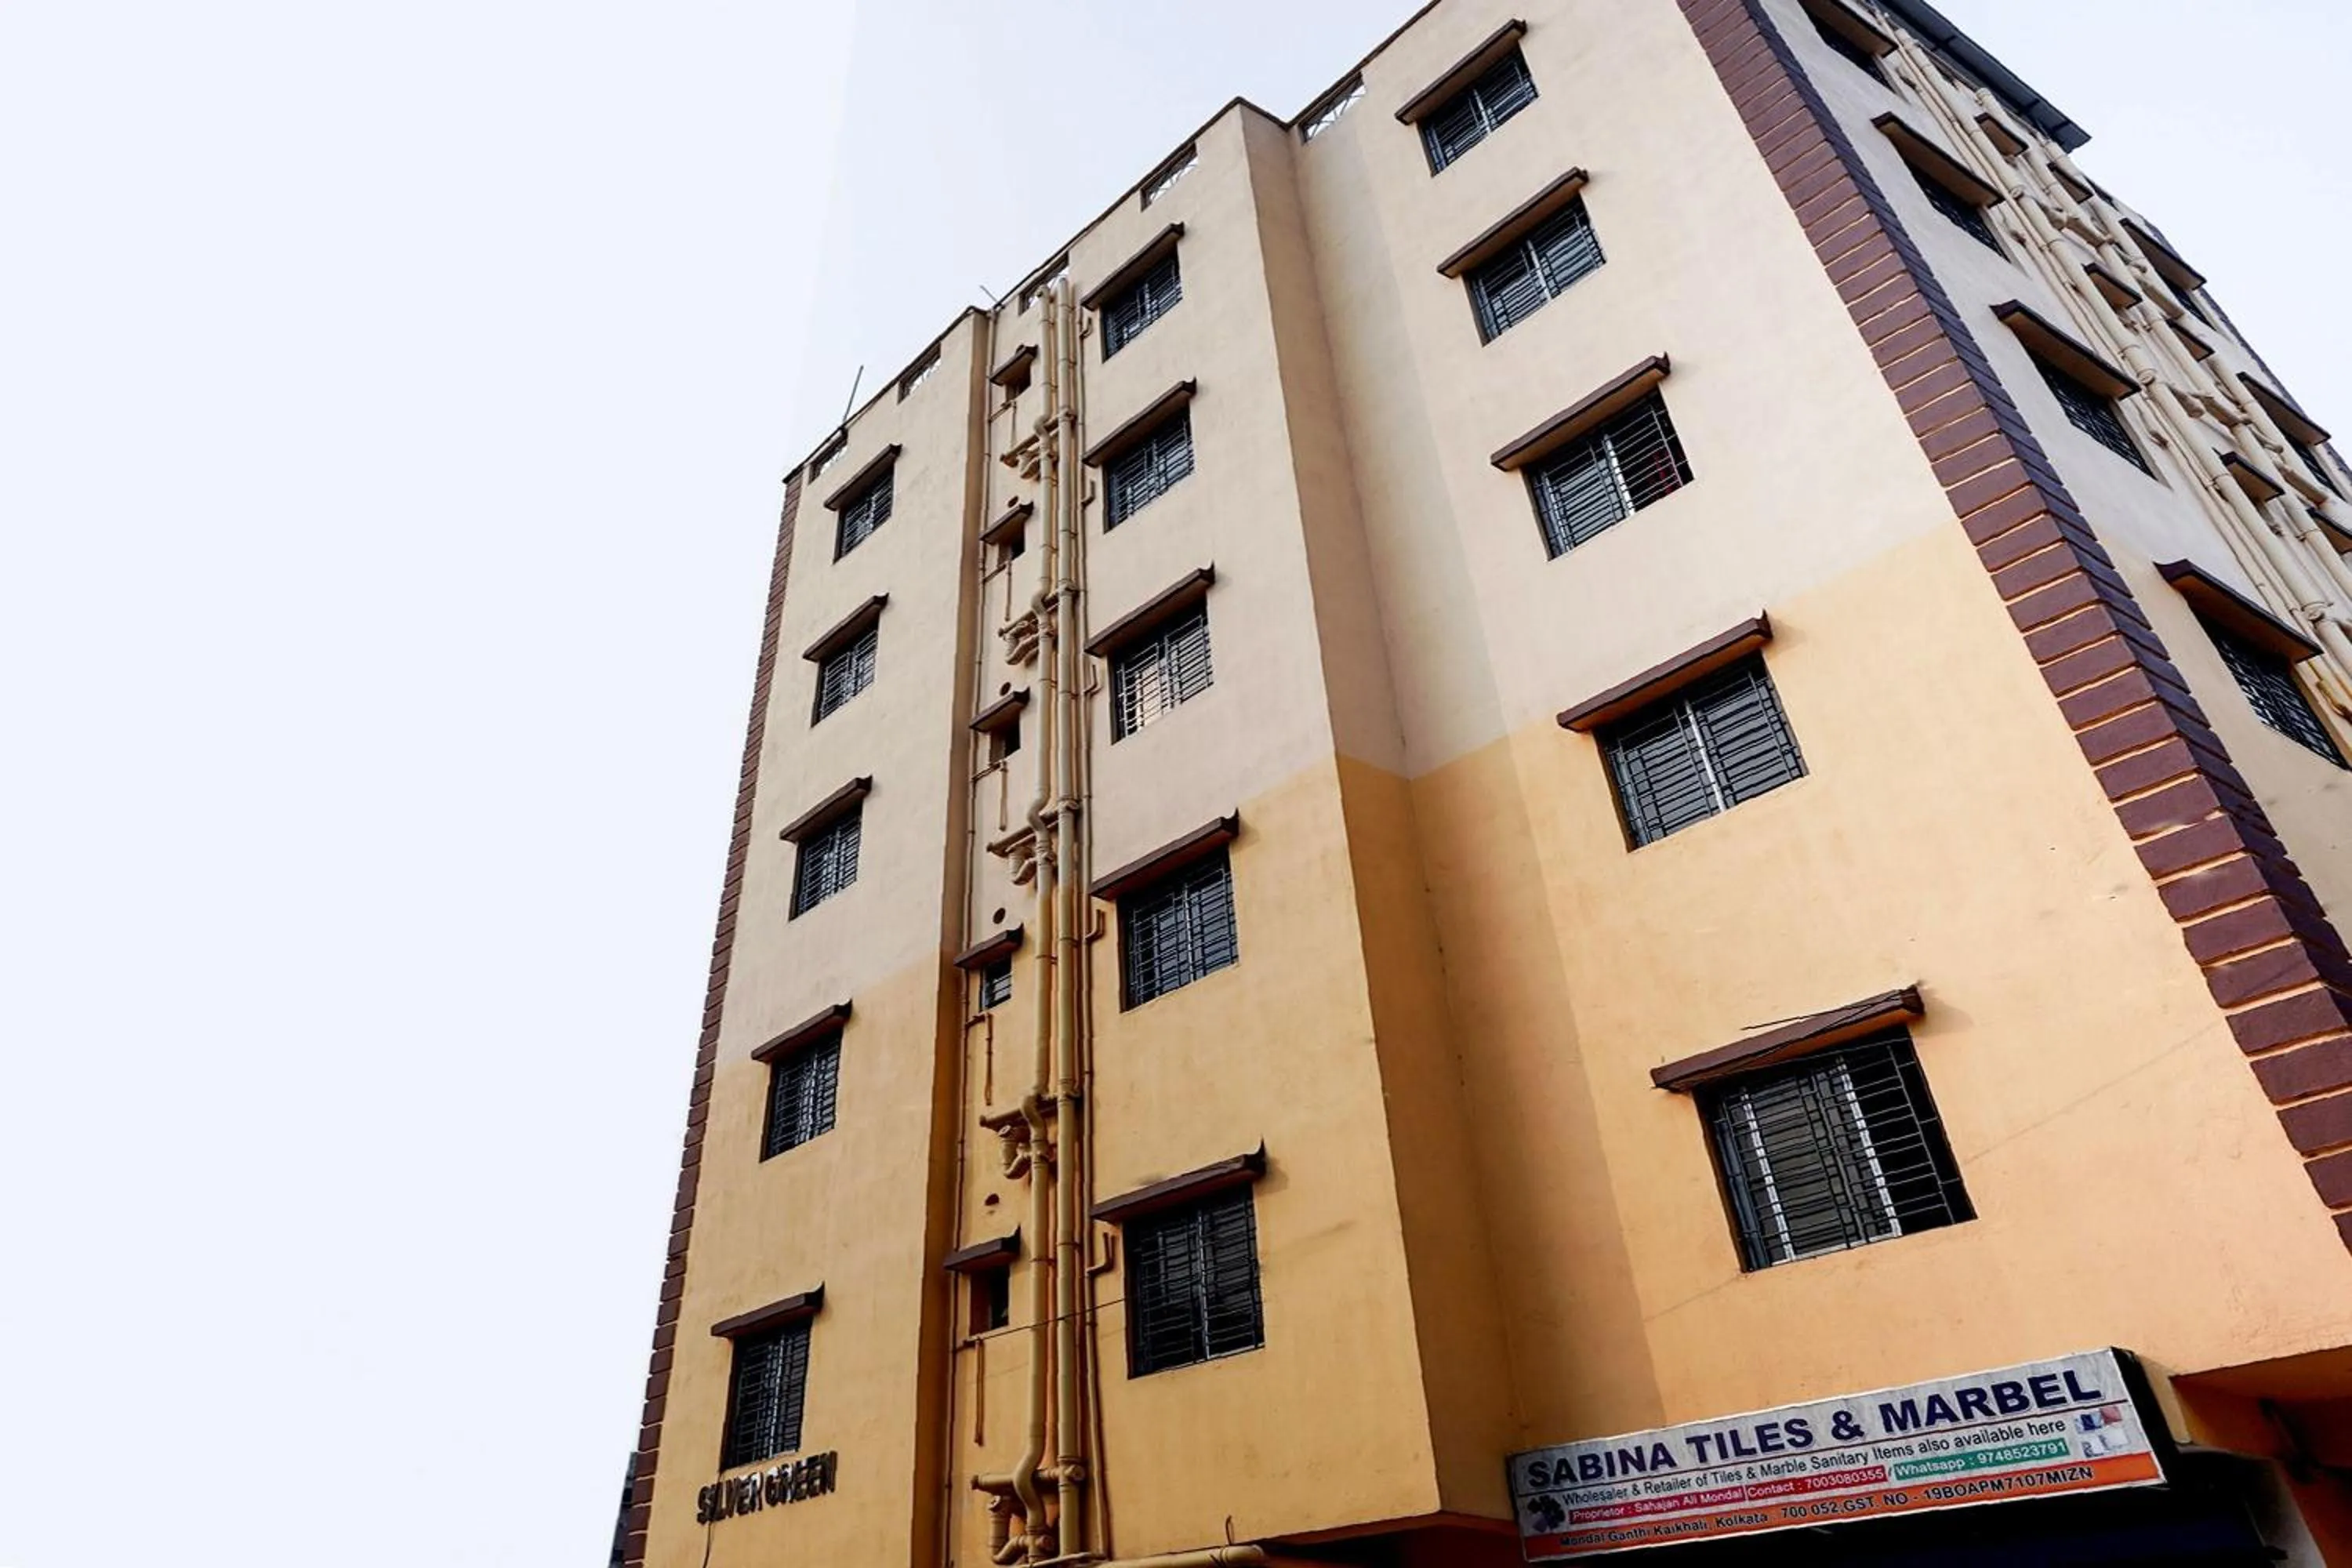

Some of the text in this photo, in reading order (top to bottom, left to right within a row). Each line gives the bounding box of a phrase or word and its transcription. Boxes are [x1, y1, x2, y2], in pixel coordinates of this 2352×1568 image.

[1528, 1370, 2102, 1487] SABINA TILES & MARBEL
[1563, 1419, 2067, 1507] Wholesaler & Retailer of Tiles & Marble Sanitary Items also available here
[765, 1450, 838, 1508] GREEN
[1573, 1507, 1624, 1520] Proprietor
[1634, 1497, 1680, 1514] Sahajan
[1700, 1488, 1743, 1503] Mondal
[1747, 1482, 1795, 1498] Contact
[1894, 1457, 1965, 1477] Whatsapp
[1976, 1441, 2068, 1464] 9748523791
[1715, 1513, 1769, 1528] Kolkata
[1780, 1504, 1807, 1519] 700
[1883, 1491, 1908, 1506] NO
